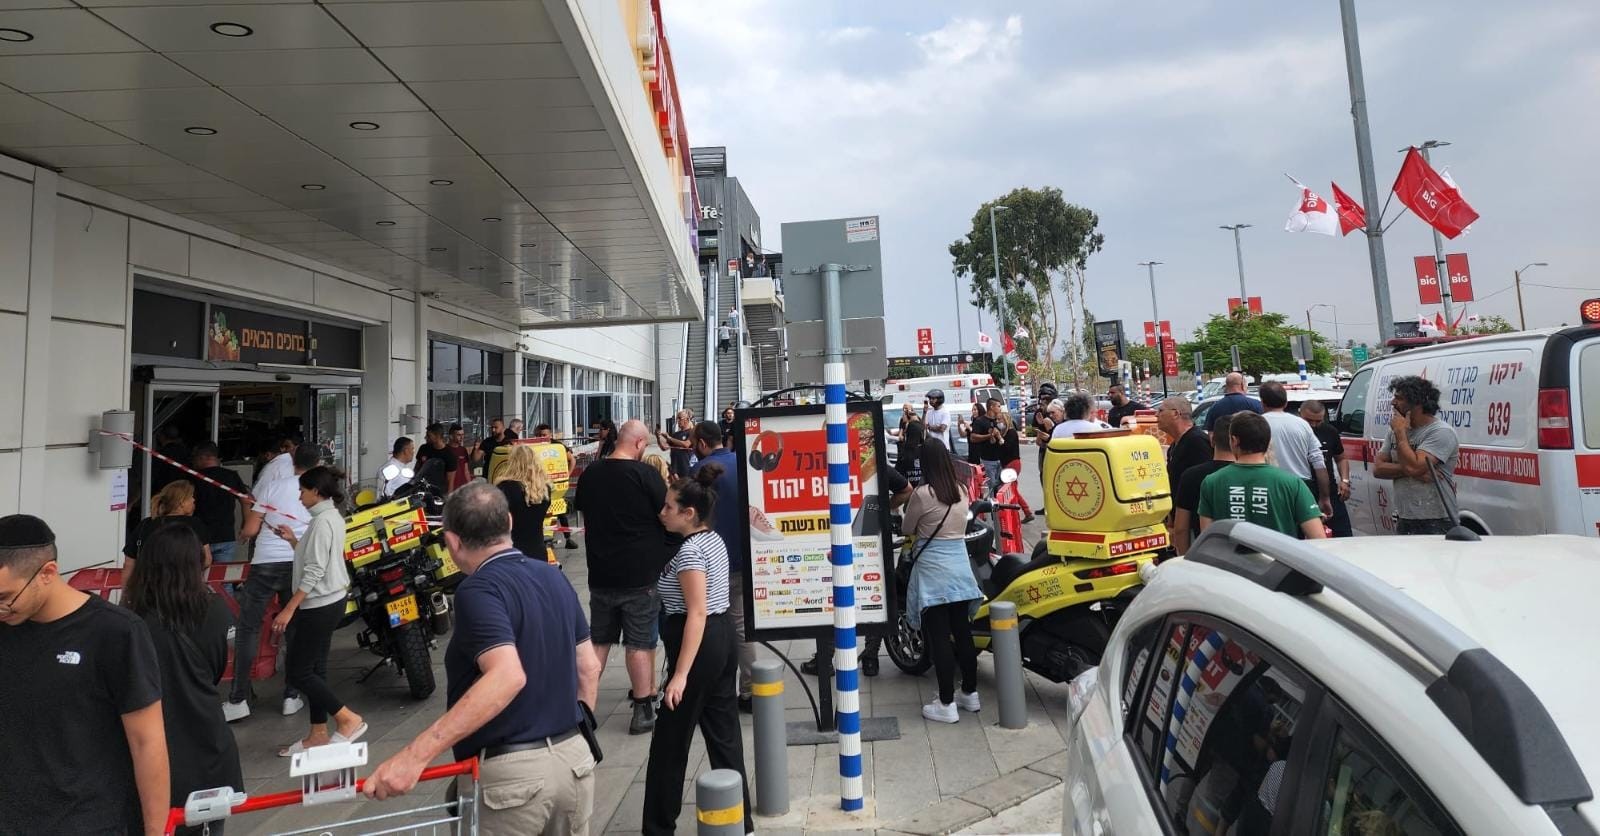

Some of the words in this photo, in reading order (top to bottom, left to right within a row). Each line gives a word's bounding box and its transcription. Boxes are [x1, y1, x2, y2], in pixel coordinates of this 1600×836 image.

[242, 328, 273, 349] הבאים
[277, 333, 305, 351] ברוכים
[1448, 367, 1461, 384] דוד
[1461, 366, 1478, 386] מגן
[1489, 362, 1523, 385] ירקון
[1451, 388, 1474, 405] אדום
[1488, 402, 1511, 436] 939
[1462, 452, 1469, 469] OF
[1470, 454, 1492, 472] MAGEN
[1493, 456, 1511, 475] DAVID
[1513, 457, 1536, 478] ADOM
[768, 478, 805, 499] יהוד
[1252, 487, 1268, 514] HEY!
[780, 519, 815, 532] בשבת
